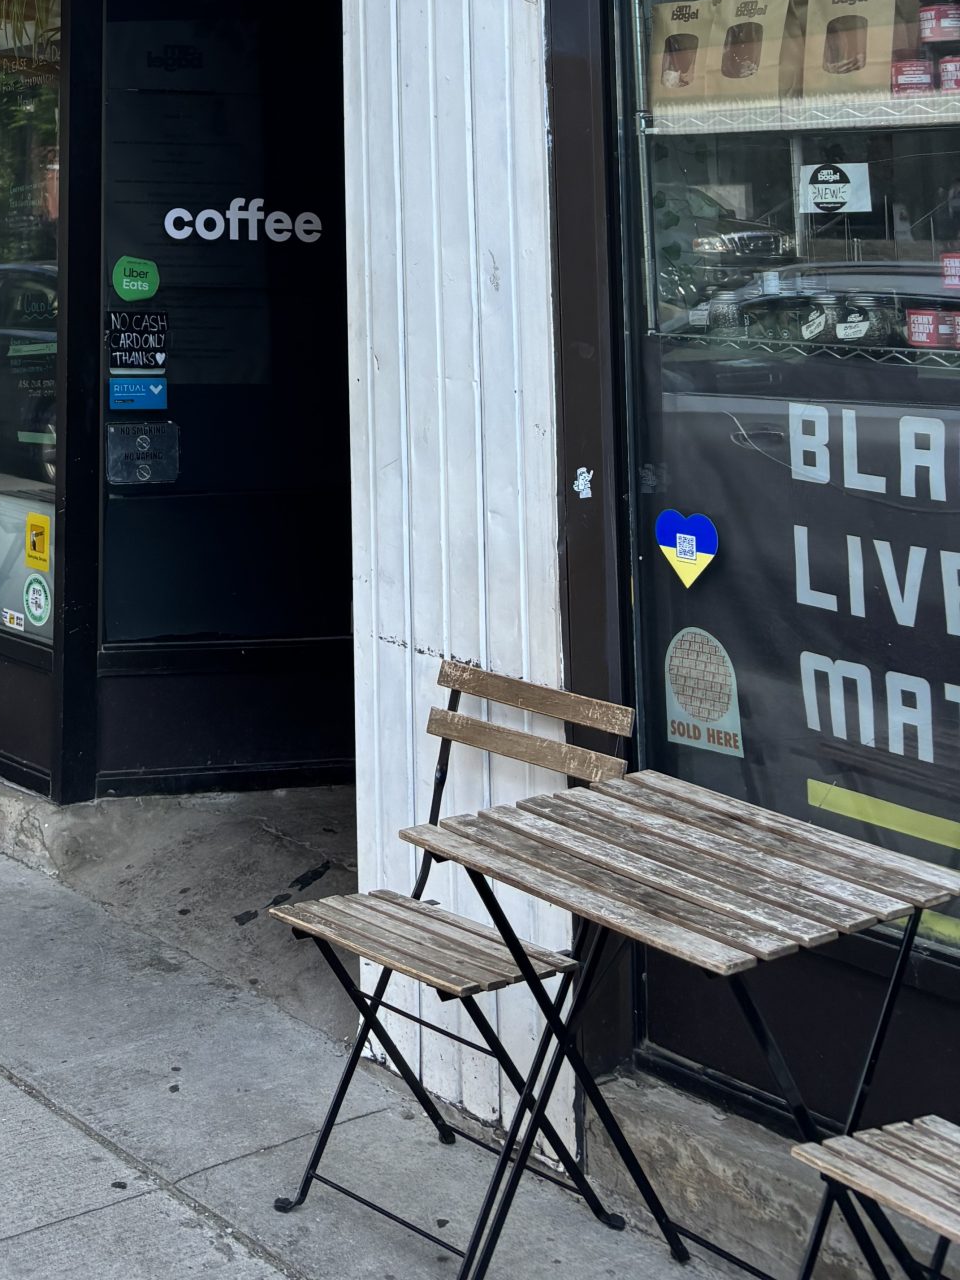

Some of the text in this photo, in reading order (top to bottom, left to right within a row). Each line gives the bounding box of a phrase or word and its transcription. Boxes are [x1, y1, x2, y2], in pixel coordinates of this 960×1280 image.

[671, 9, 699, 23] bagel
[734, 5, 768, 19] bagel
[164, 197, 323, 243] coffee
[123, 267, 149, 279] Uber
[122, 278, 150, 291] Eats
[111, 312, 168, 331] NO CASH
[110, 333, 165, 349] CARD ONLY
[112, 351, 156, 367] THANKS
[114, 383, 146, 392] RITUAL
[788, 402, 946, 502] BLA
[670, 717, 741, 751] SOLD HERE
